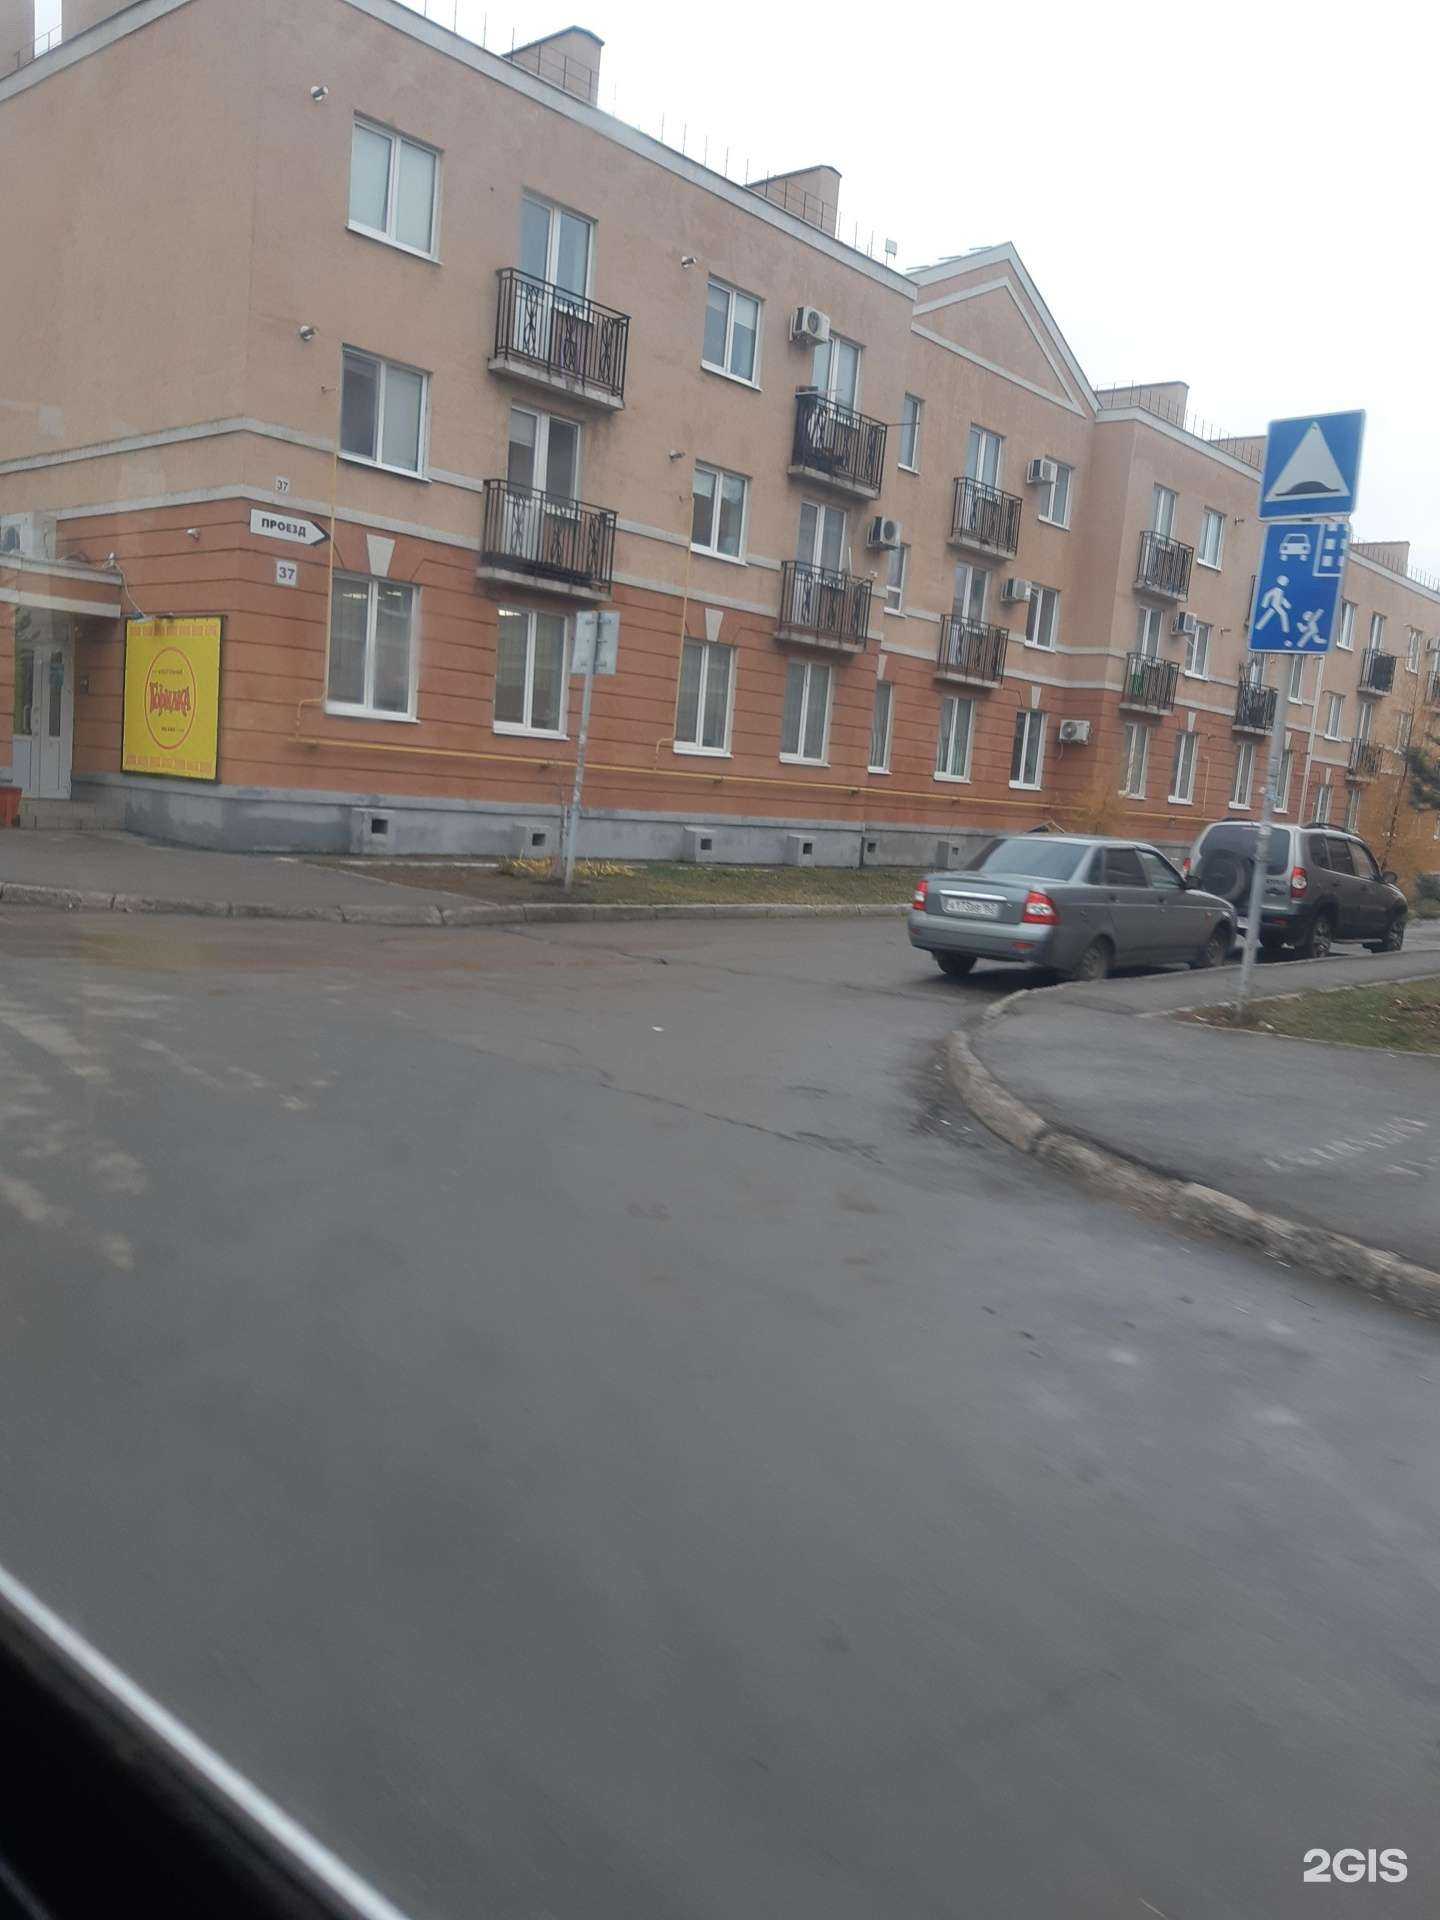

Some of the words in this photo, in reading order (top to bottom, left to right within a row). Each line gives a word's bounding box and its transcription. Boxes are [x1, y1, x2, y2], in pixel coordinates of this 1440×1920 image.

[276, 479, 289, 492] 37
[261, 517, 307, 538] ПРОЕЗД
[278, 566, 296, 580] 37
